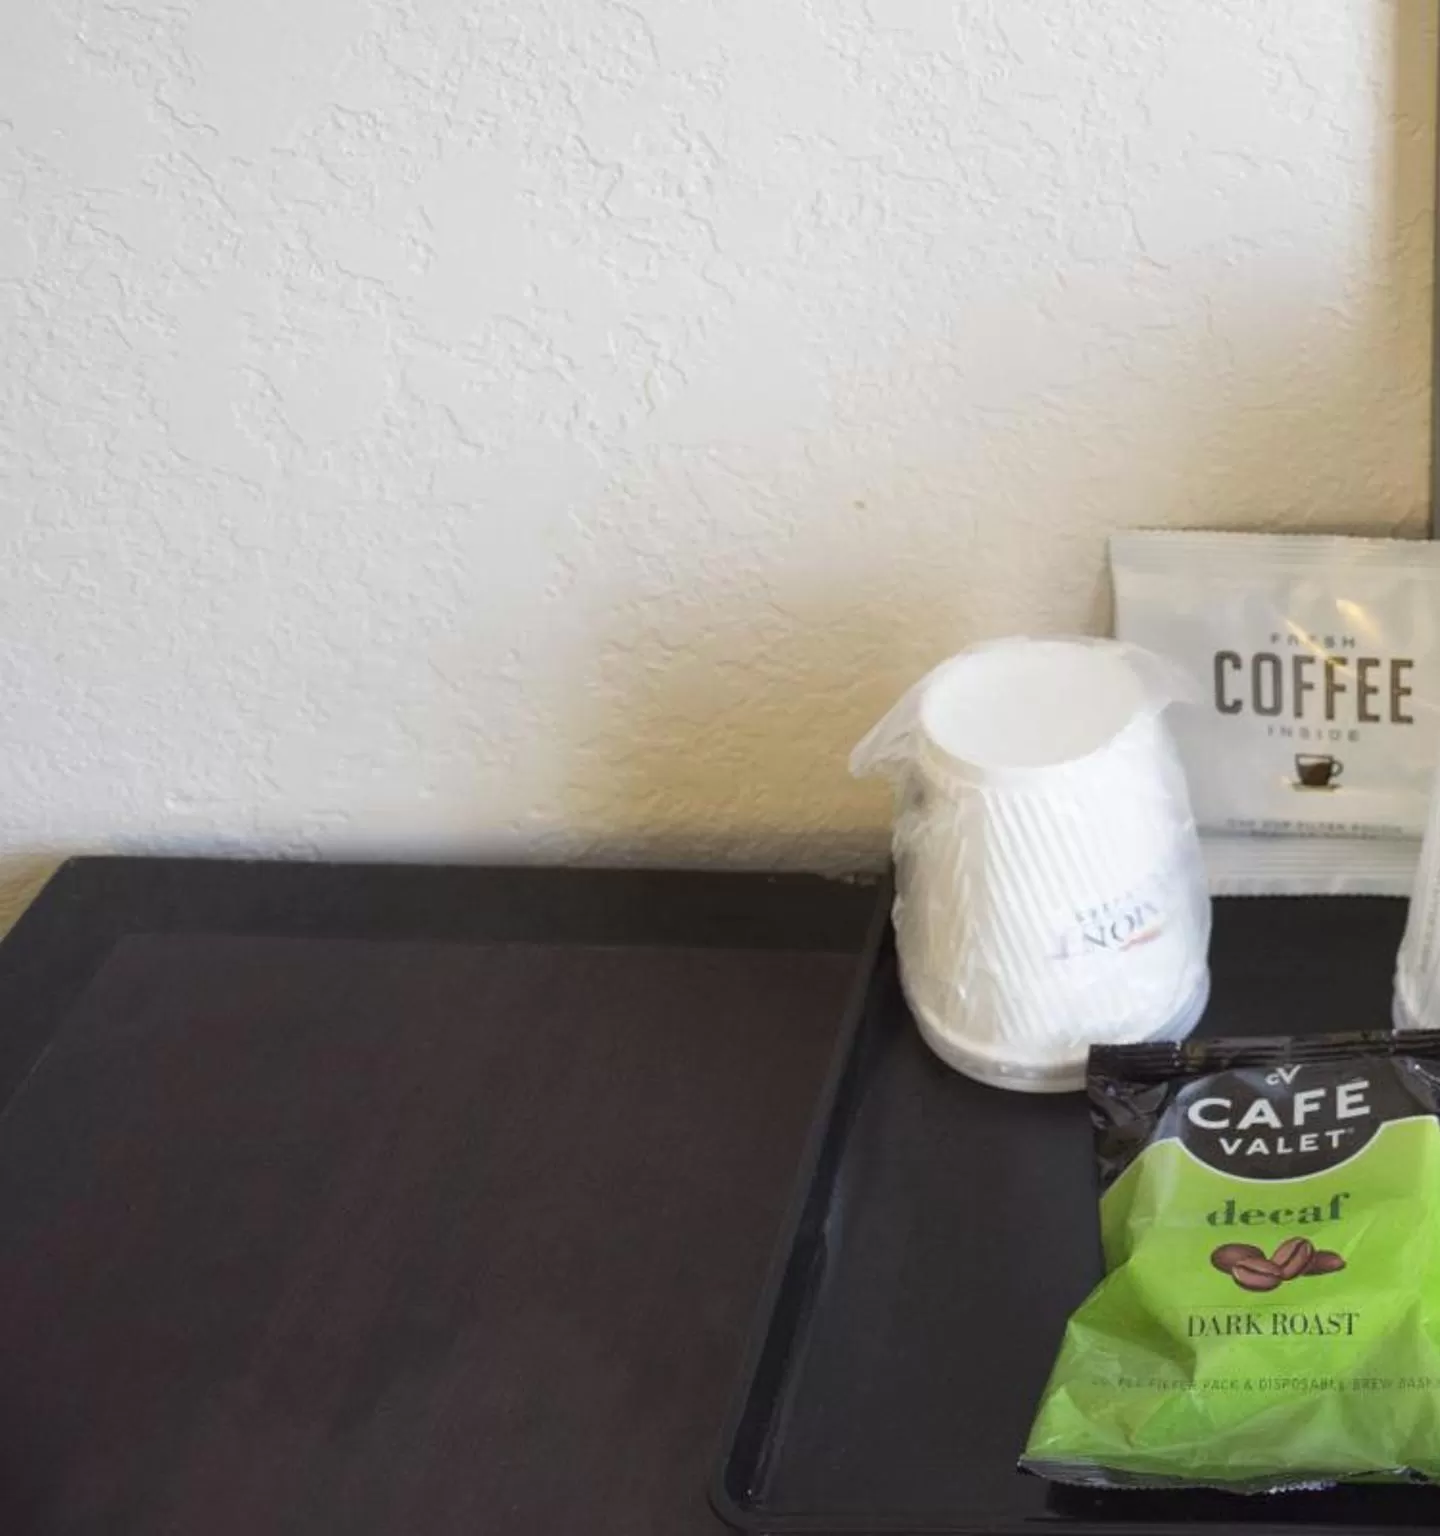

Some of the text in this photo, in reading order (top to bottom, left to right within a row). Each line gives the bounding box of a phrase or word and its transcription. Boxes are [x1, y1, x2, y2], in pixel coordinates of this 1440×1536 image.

[1270, 633, 1356, 649] FRSH
[1213, 650, 1415, 725] COFFEE
[1267, 724, 1360, 743] INSIDE
[1219, 1129, 1346, 1156] VALET
[1207, 1193, 1350, 1228] decaf
[1187, 1312, 1360, 1338] DARK ROAST
[1202, 1378, 1237, 1391] PACK
